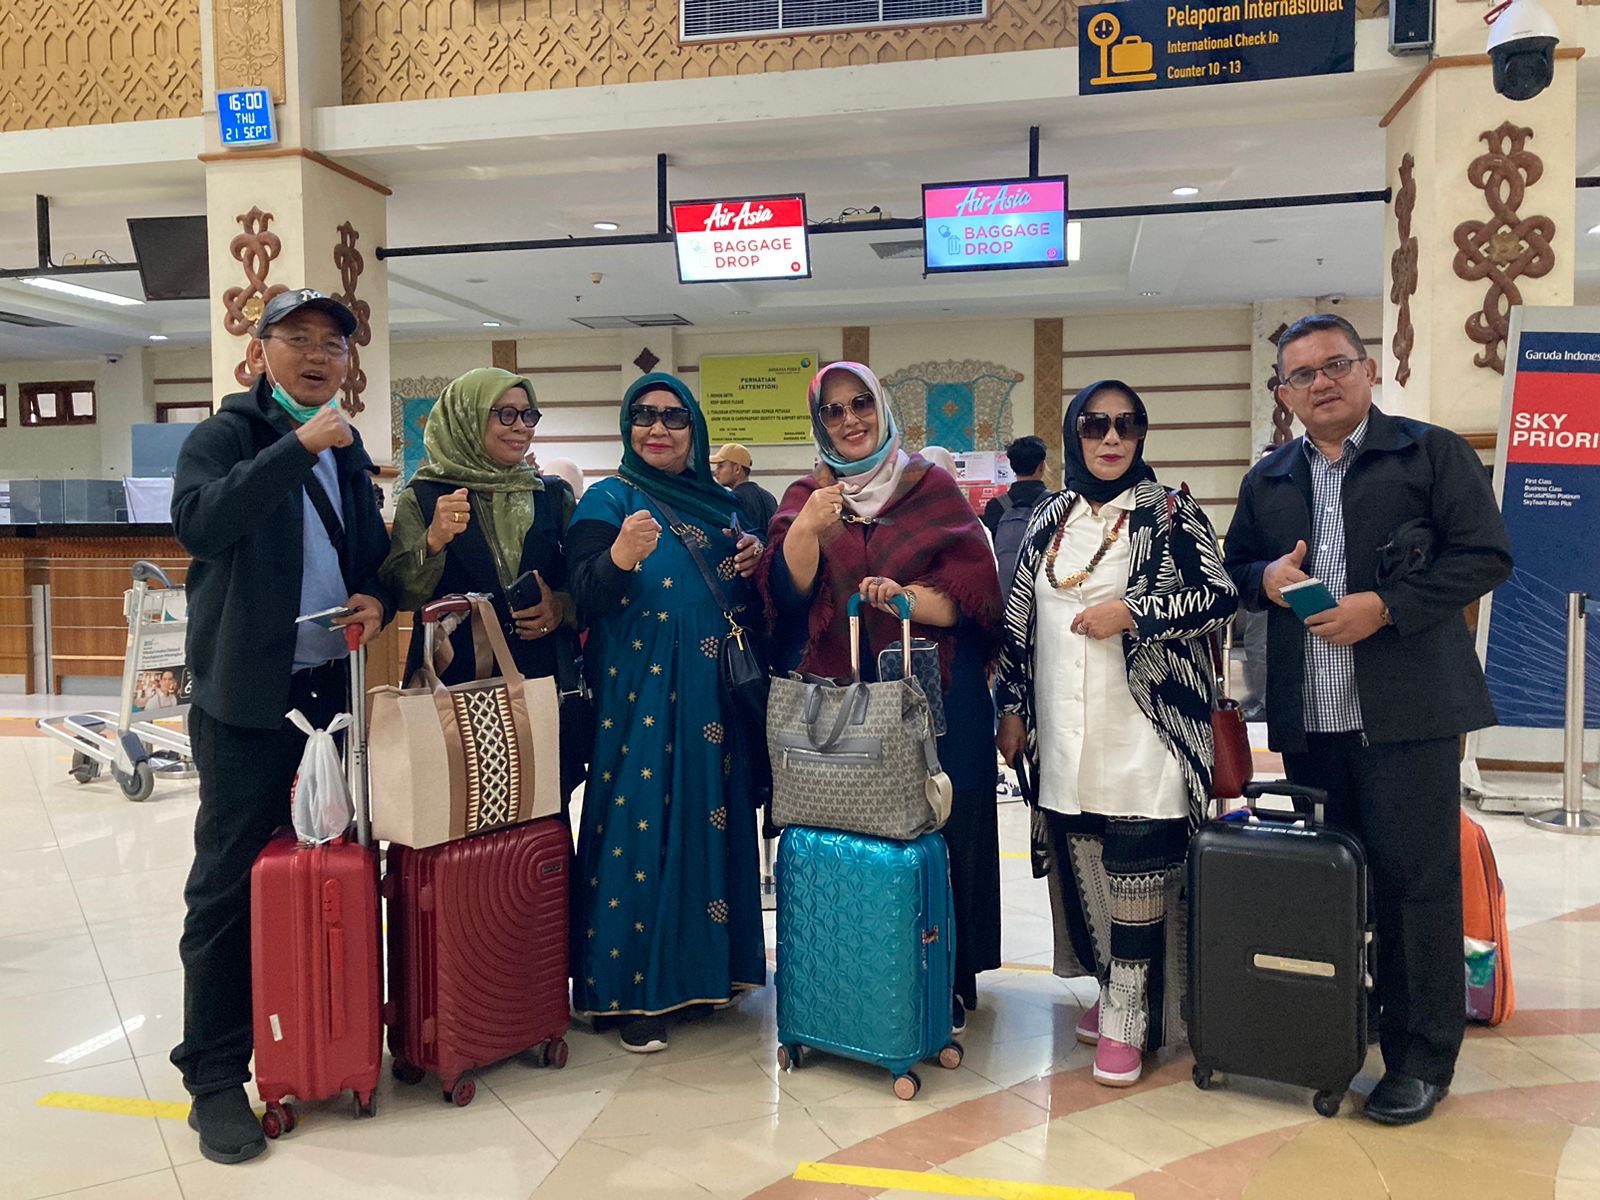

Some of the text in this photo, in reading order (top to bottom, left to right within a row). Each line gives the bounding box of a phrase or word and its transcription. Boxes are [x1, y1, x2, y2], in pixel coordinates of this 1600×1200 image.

[1167, 4, 1241, 31] Pelaporan
[1167, 29, 1279, 54] International Check In
[1167, 65, 1206, 79] Counter
[1208, 61, 1220, 76] 10
[1229, 59, 1241, 74] 13
[229, 92, 263, 111] 16:00
[235, 112, 256, 124] THU
[225, 125, 267, 141] 21 SEPT
[964, 222, 1051, 240] BAGGAGE
[713, 238, 792, 253] BAGGAGE
[964, 241, 1014, 256] DROP
[715, 255, 760, 269] DROP
[1525, 350, 1563, 361] Garuda
[1515, 412, 1568, 430] SKY
[1512, 431, 1599, 448] PRIORI
